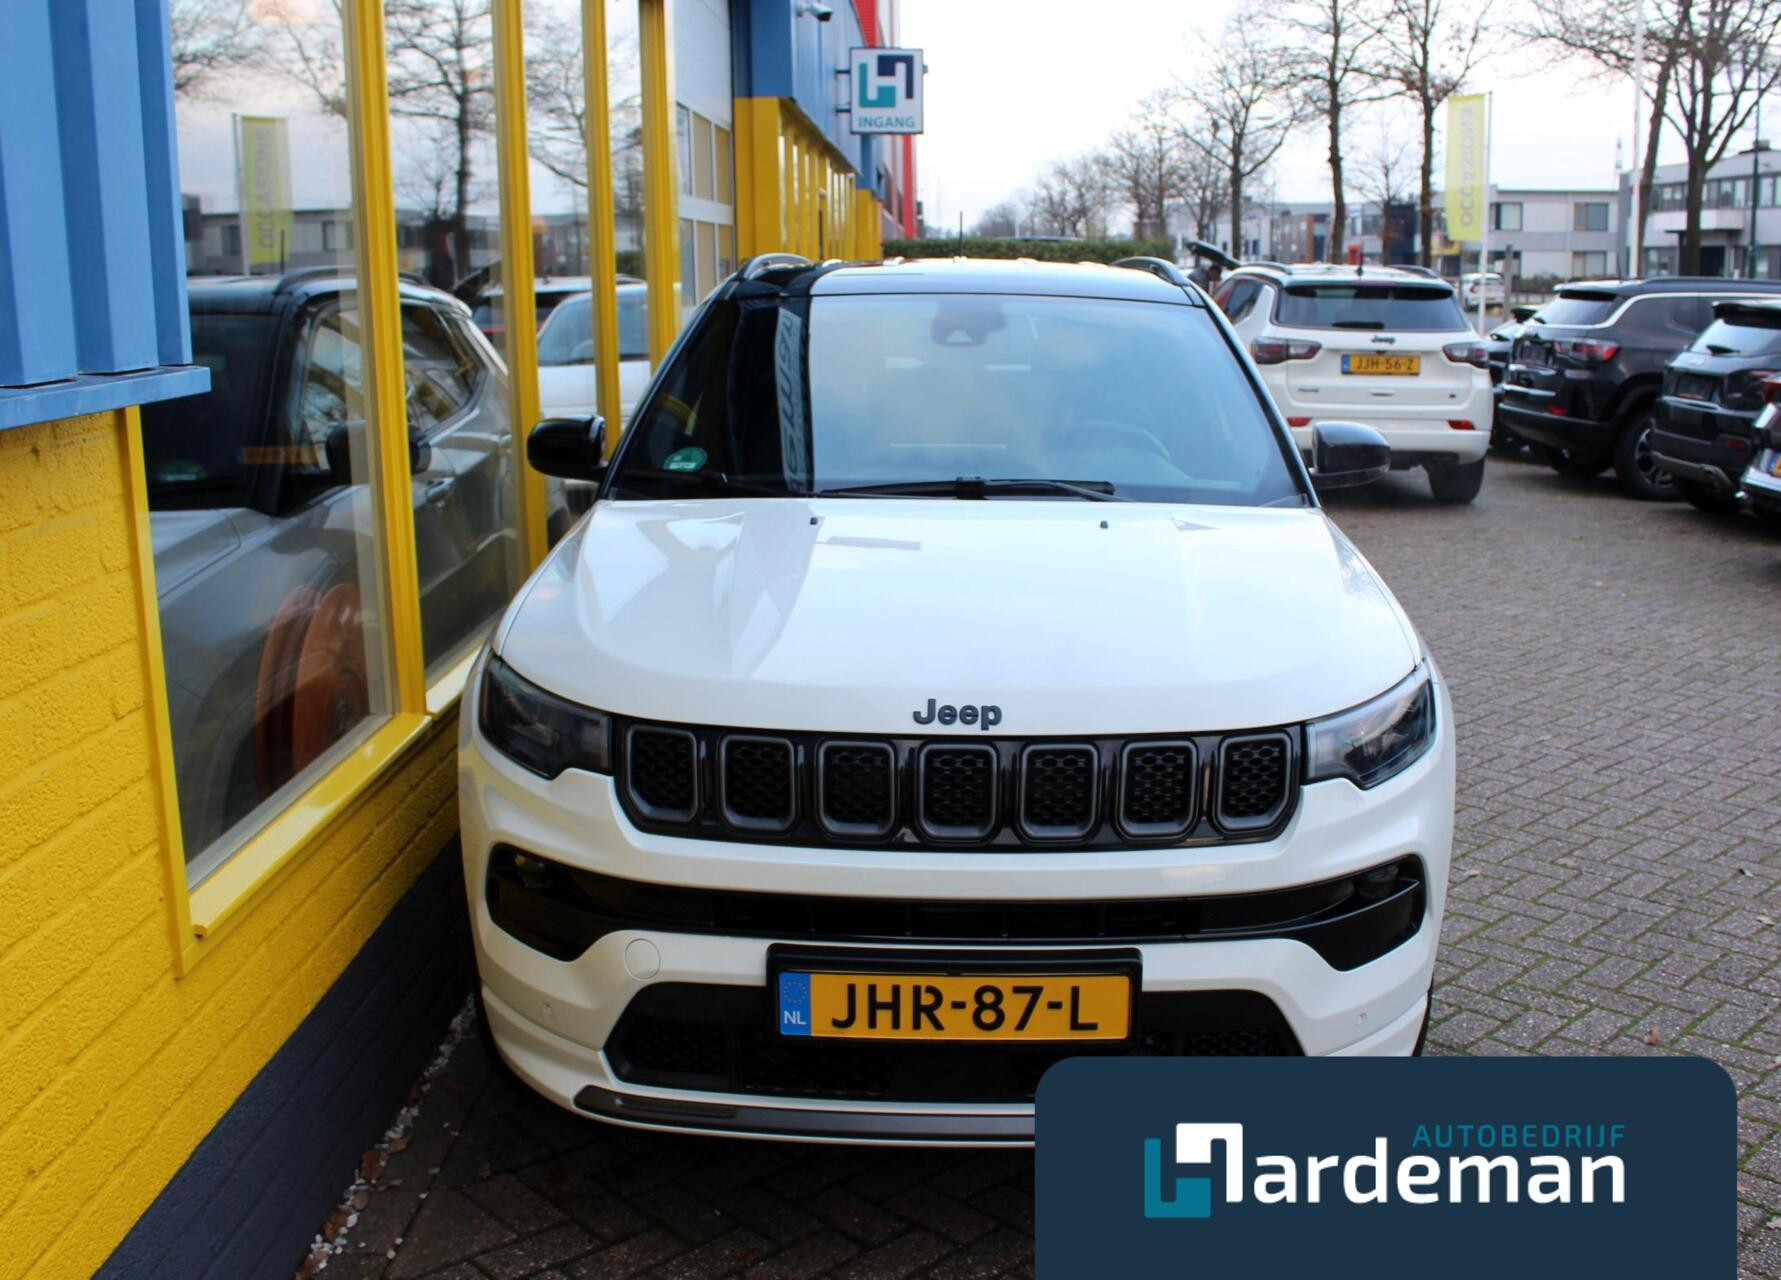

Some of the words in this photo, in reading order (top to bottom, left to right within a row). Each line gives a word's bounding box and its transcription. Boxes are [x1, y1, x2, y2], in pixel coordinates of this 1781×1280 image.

[858, 116, 915, 128] INGANG
[913, 698, 1002, 731] Jeep
[783, 1010, 806, 1025] NL
[831, 983, 1099, 1032] JHR-87-L
